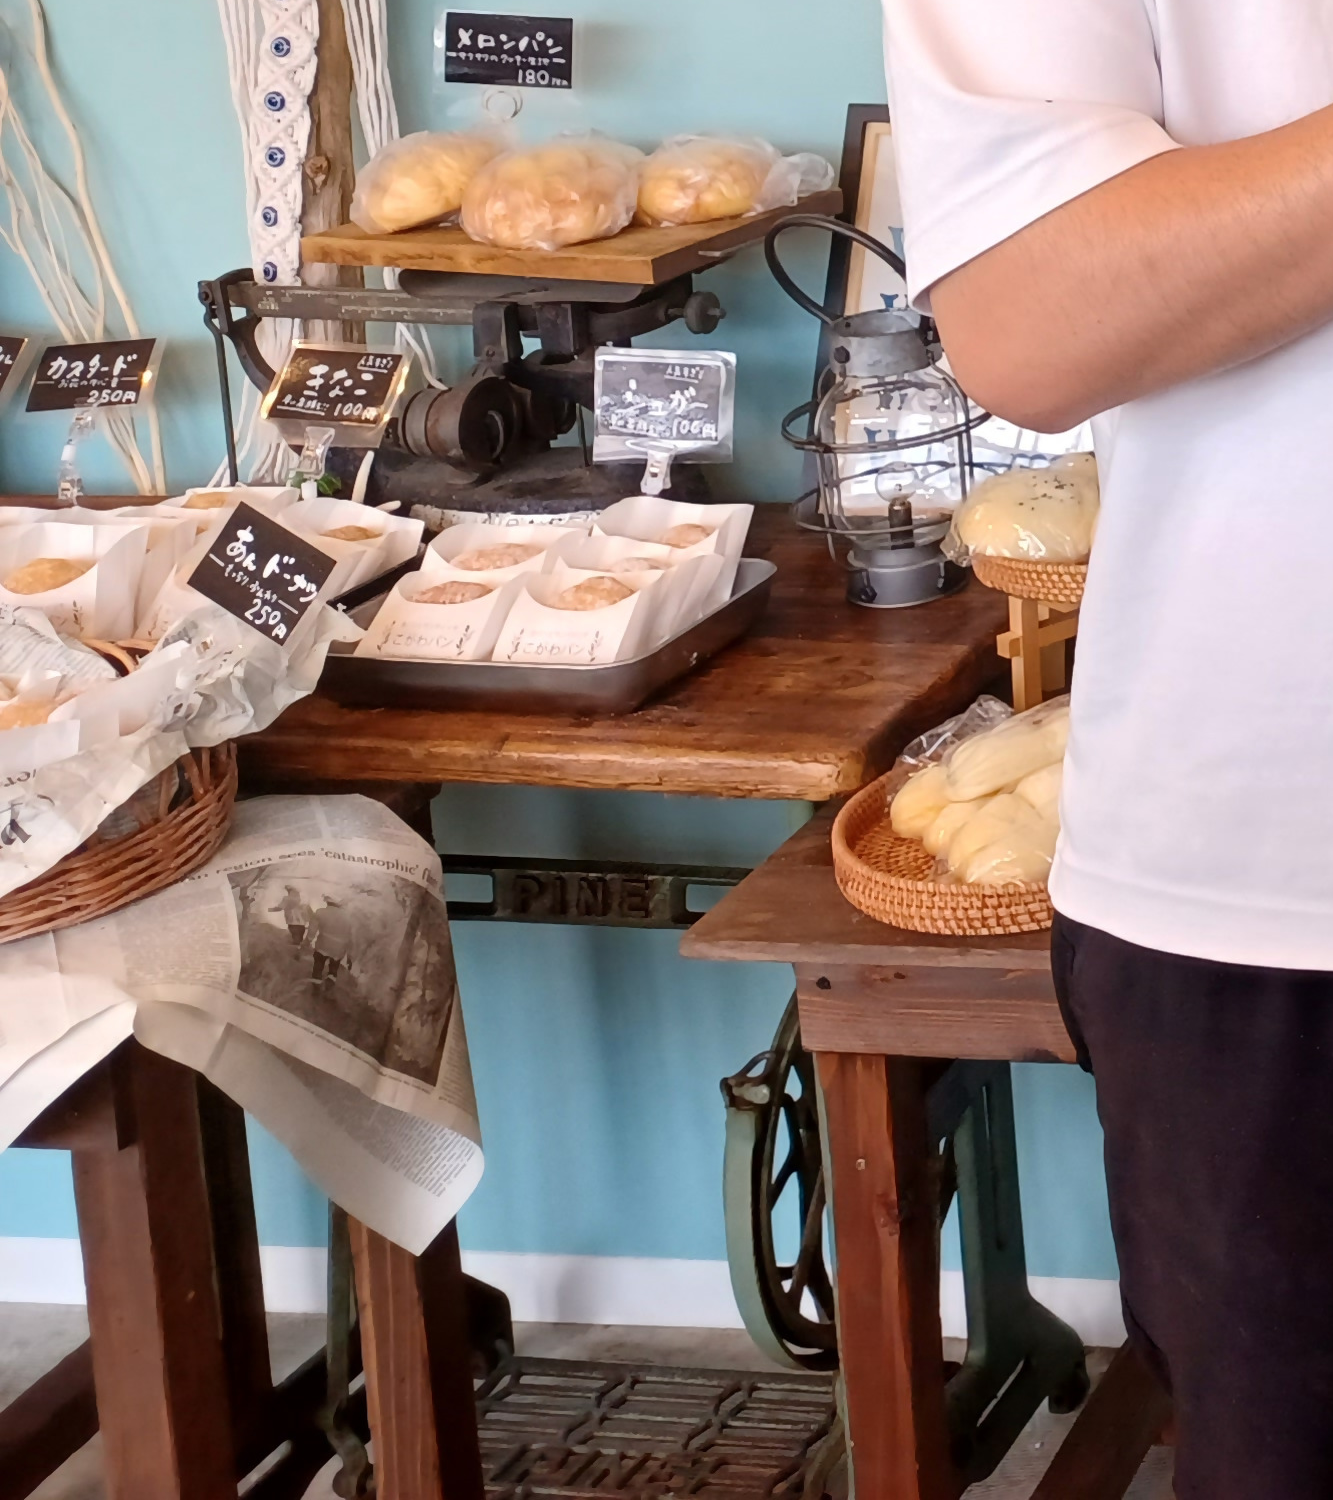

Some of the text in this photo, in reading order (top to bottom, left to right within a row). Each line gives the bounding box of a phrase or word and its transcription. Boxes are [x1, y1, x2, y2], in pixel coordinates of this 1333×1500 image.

[457, 27, 563, 54] メロンパン
[47, 353, 138, 380] カスタード
[302, 363, 375, 398] きなこ
[86, 389, 137, 404] 250円
[244, 598, 288, 640] 250円
[513, 874, 653, 919] PINE
